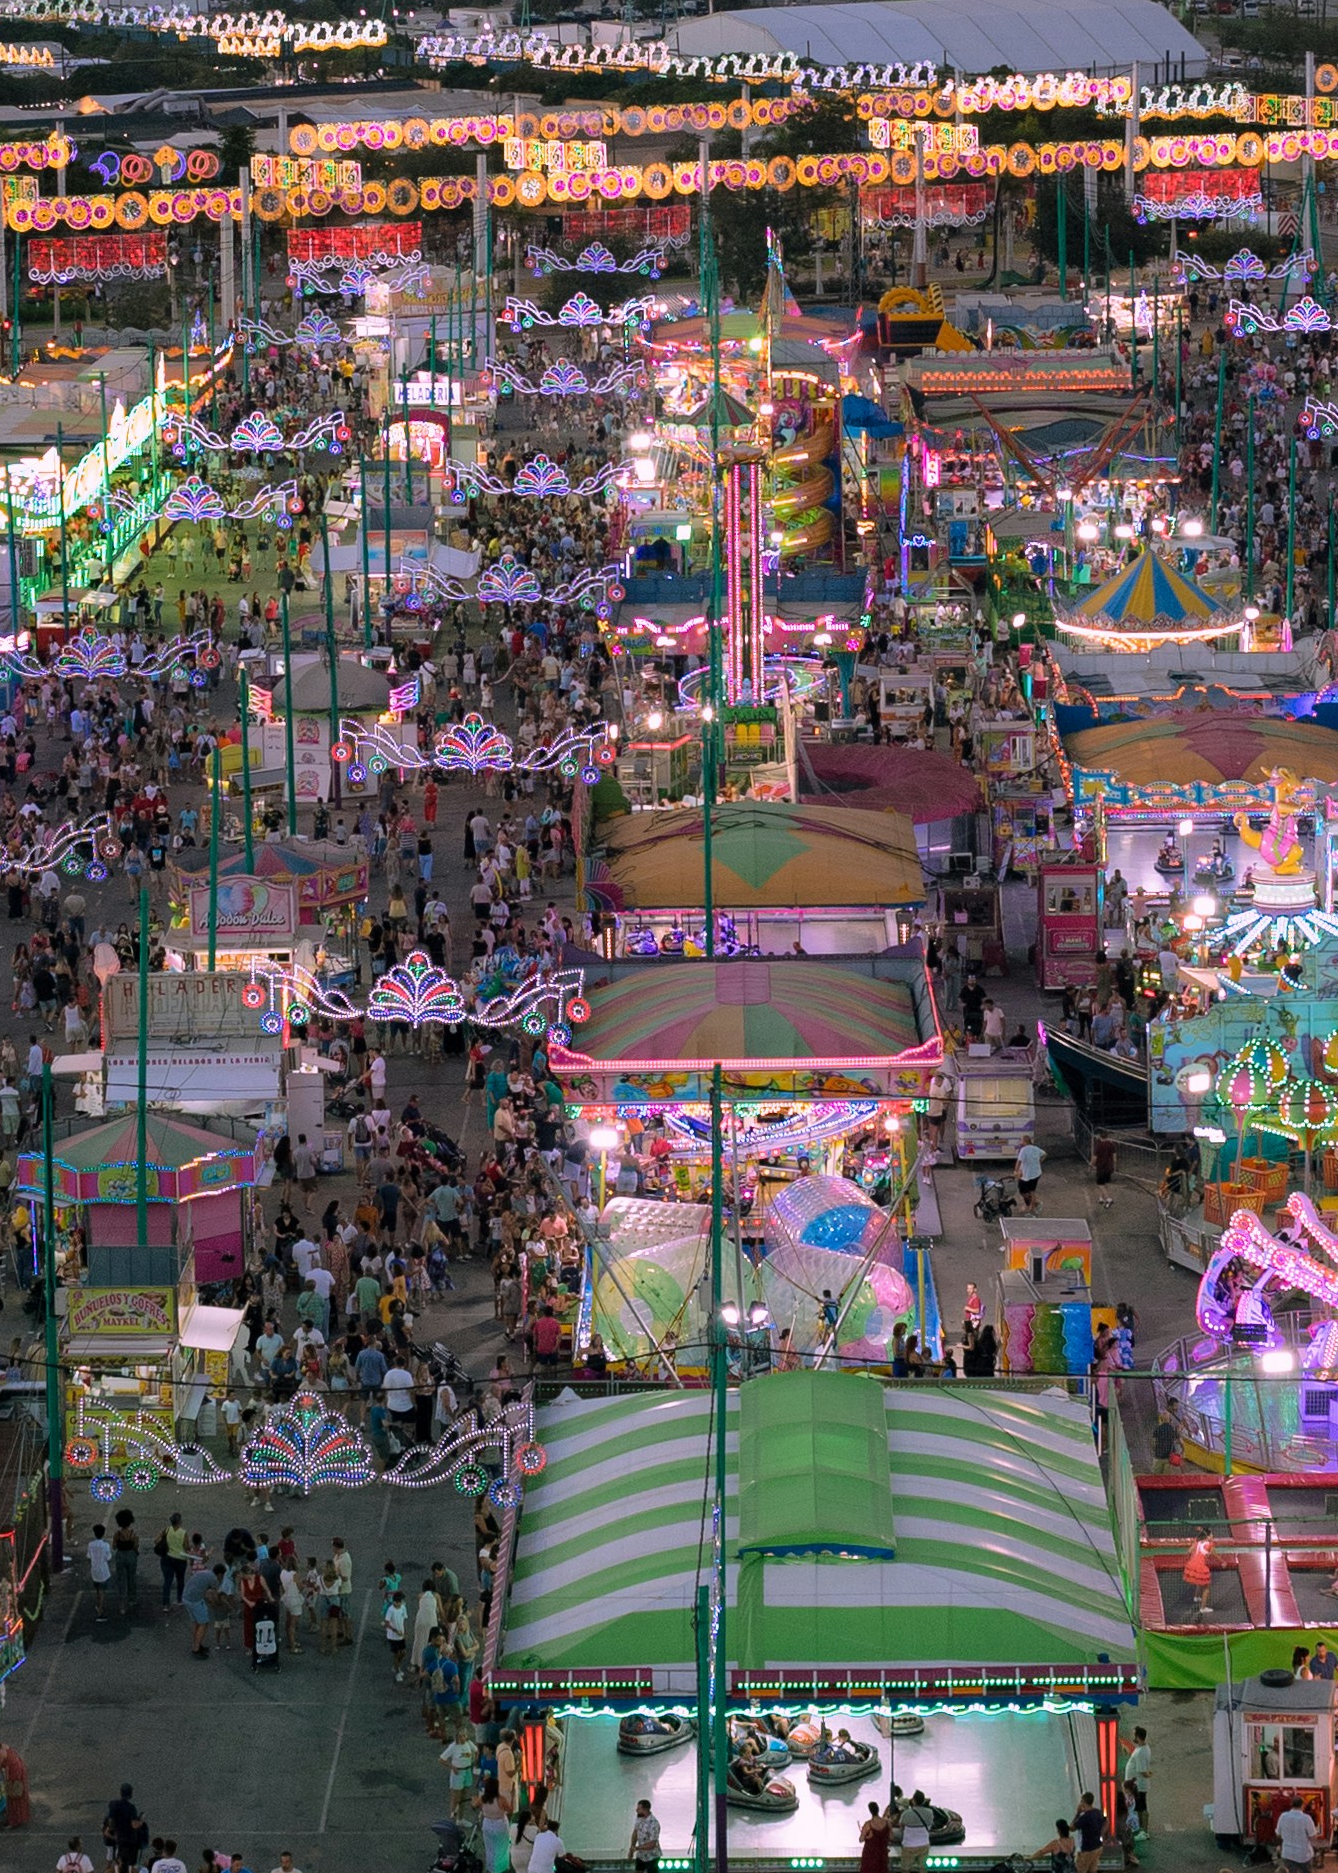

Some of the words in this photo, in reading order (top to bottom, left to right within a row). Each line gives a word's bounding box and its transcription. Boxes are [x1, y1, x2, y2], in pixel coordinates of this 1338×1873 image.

[250, 912, 286, 926] Dulce
[108, 1058, 124, 1067] LOS
[128, 1057, 168, 1067] MEORES
[229, 1056, 240, 1065] LA
[130, 1295, 168, 1325] GOFRES
[102, 1316, 139, 1327] MAYKEL
